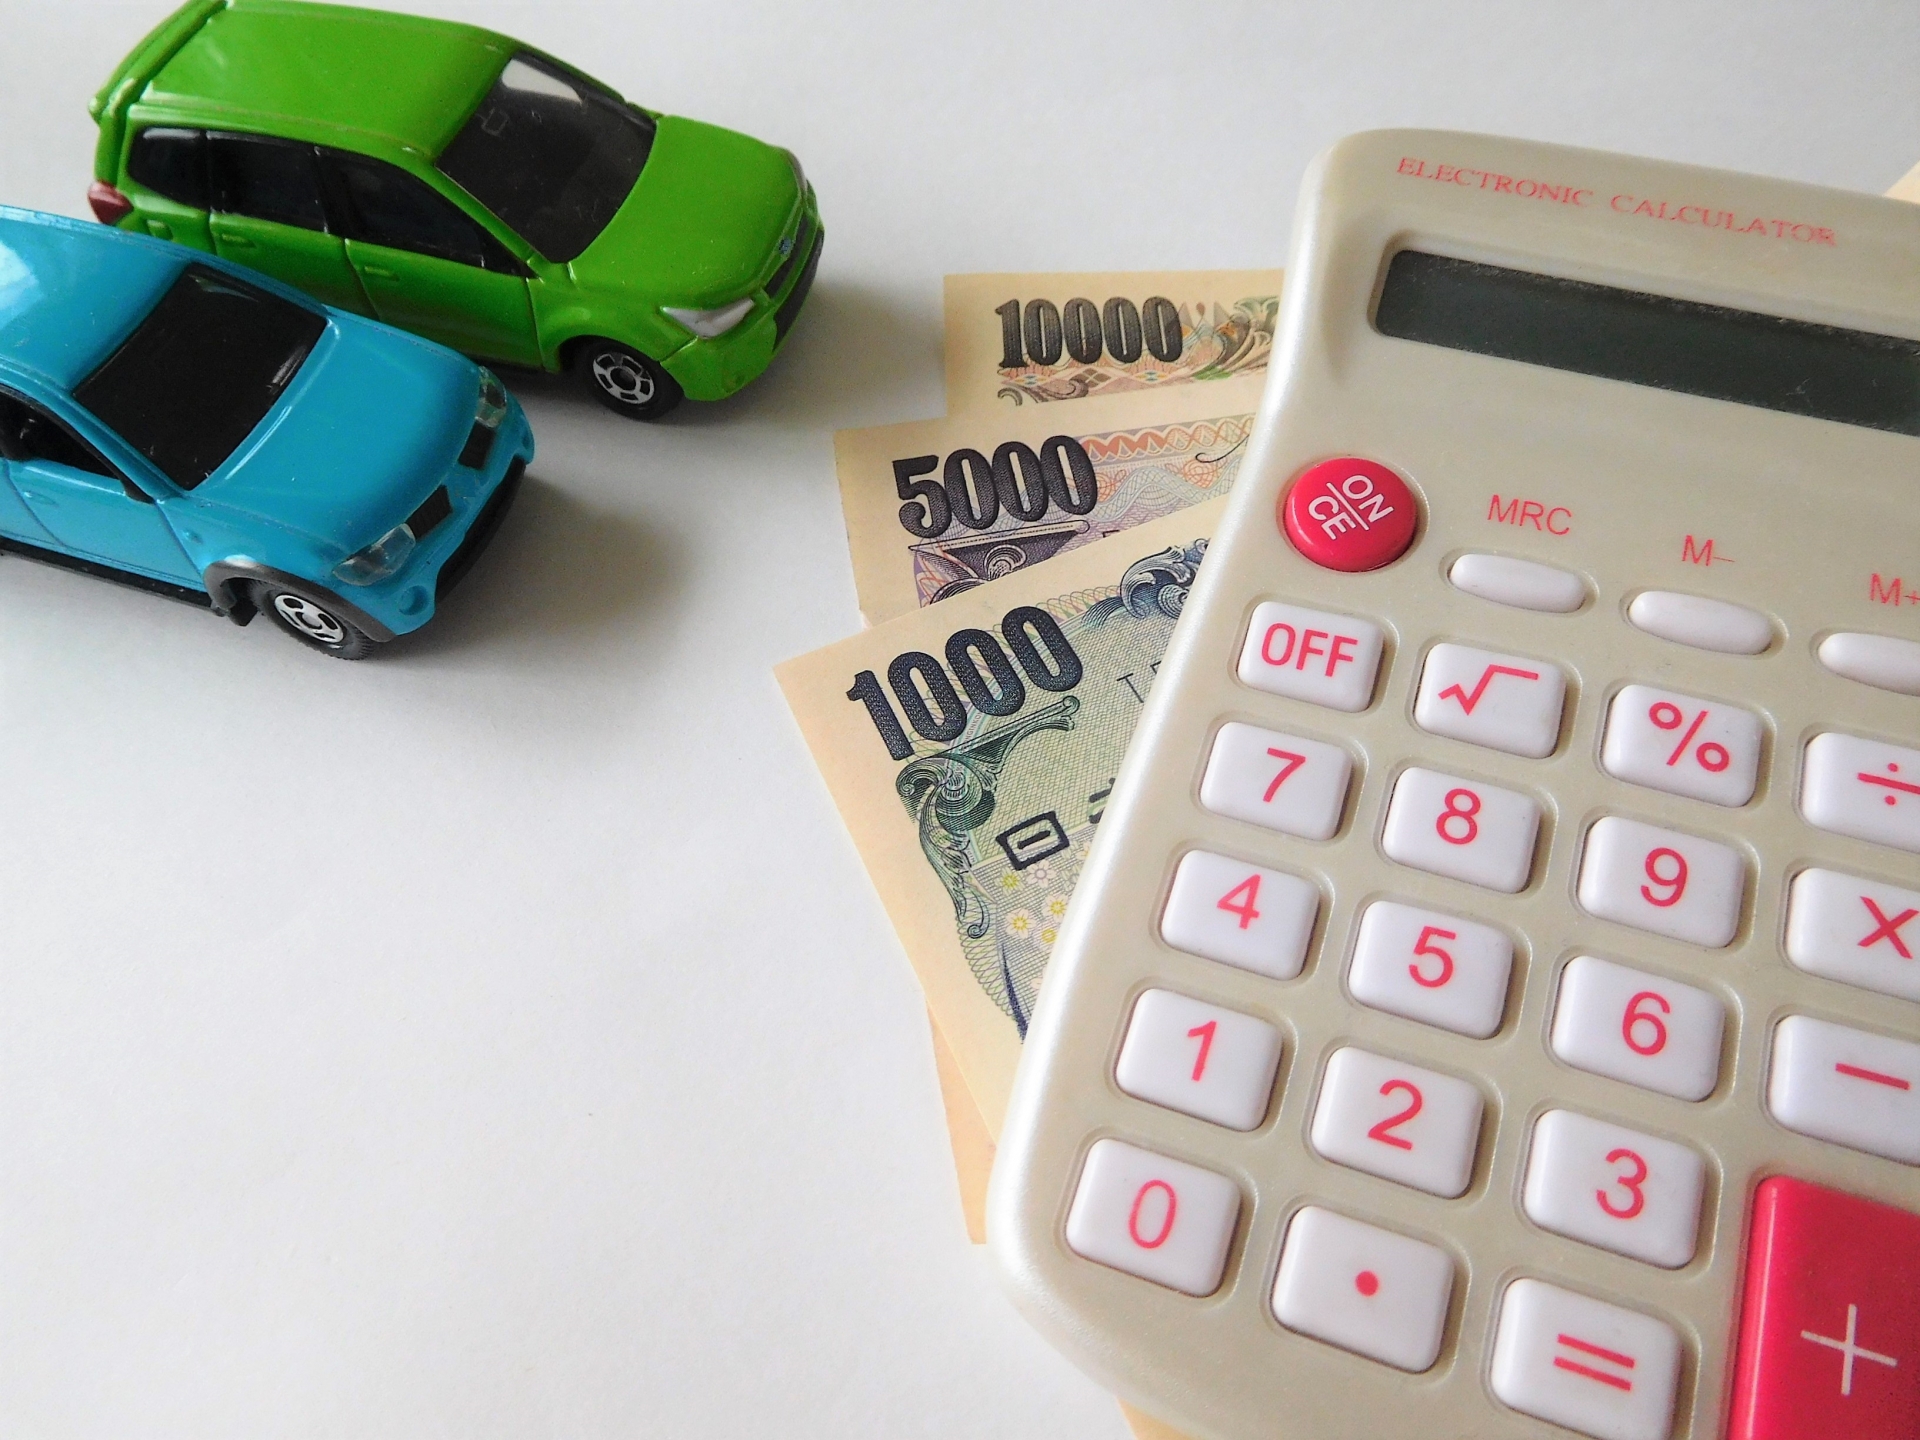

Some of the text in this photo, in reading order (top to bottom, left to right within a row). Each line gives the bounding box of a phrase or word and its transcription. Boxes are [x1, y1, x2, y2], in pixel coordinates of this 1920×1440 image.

[1395, 156, 1838, 248] ELECTRONIC CALCULATOR
[995, 295, 1184, 369] 10000
[892, 434, 1099, 540] 5000
[1307, 495, 1357, 540] CE
[1341, 474, 1395, 523] ON
[1486, 493, 1573, 537] MRC
[1260, 621, 1360, 679] OFF
[845, 605, 1083, 761] 1000
[1262, 746, 1308, 804] 7
[1434, 787, 1483, 847] 8
[1216, 873, 1263, 931] 4
[1639, 846, 1690, 909] 9
[1407, 924, 1458, 990] 5
[1186, 1019, 1219, 1083] 1
[1620, 989, 1673, 1058] 6
[1366, 1077, 1425, 1152] 2
[1126, 1178, 1180, 1251] 0
[1594, 1146, 1650, 1221] 3
